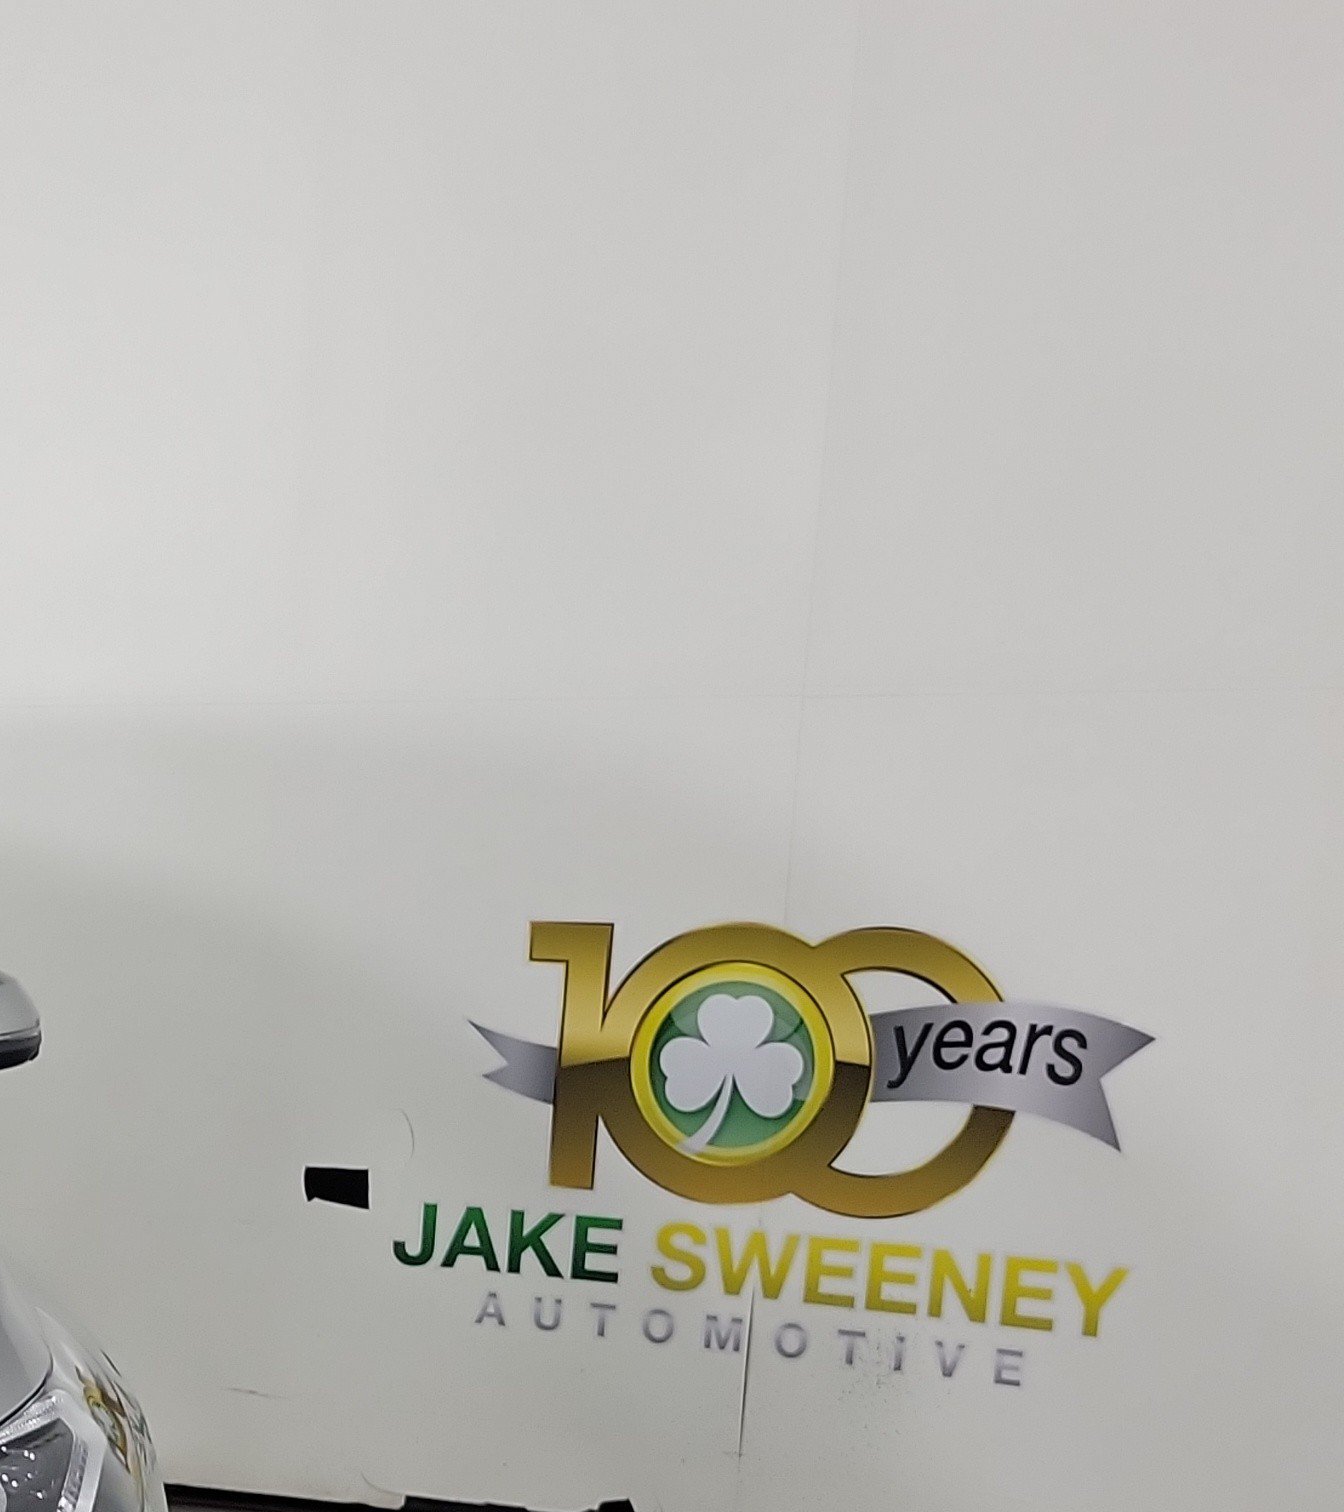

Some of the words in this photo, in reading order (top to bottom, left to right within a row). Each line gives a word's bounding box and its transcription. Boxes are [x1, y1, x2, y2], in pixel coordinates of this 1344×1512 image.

[887, 1017, 1088, 1089] years
[392, 1202, 624, 1284] JAKE
[651, 1221, 1130, 1338] SWEENEY
[475, 1291, 1026, 1388] AUTOMOTIVE
